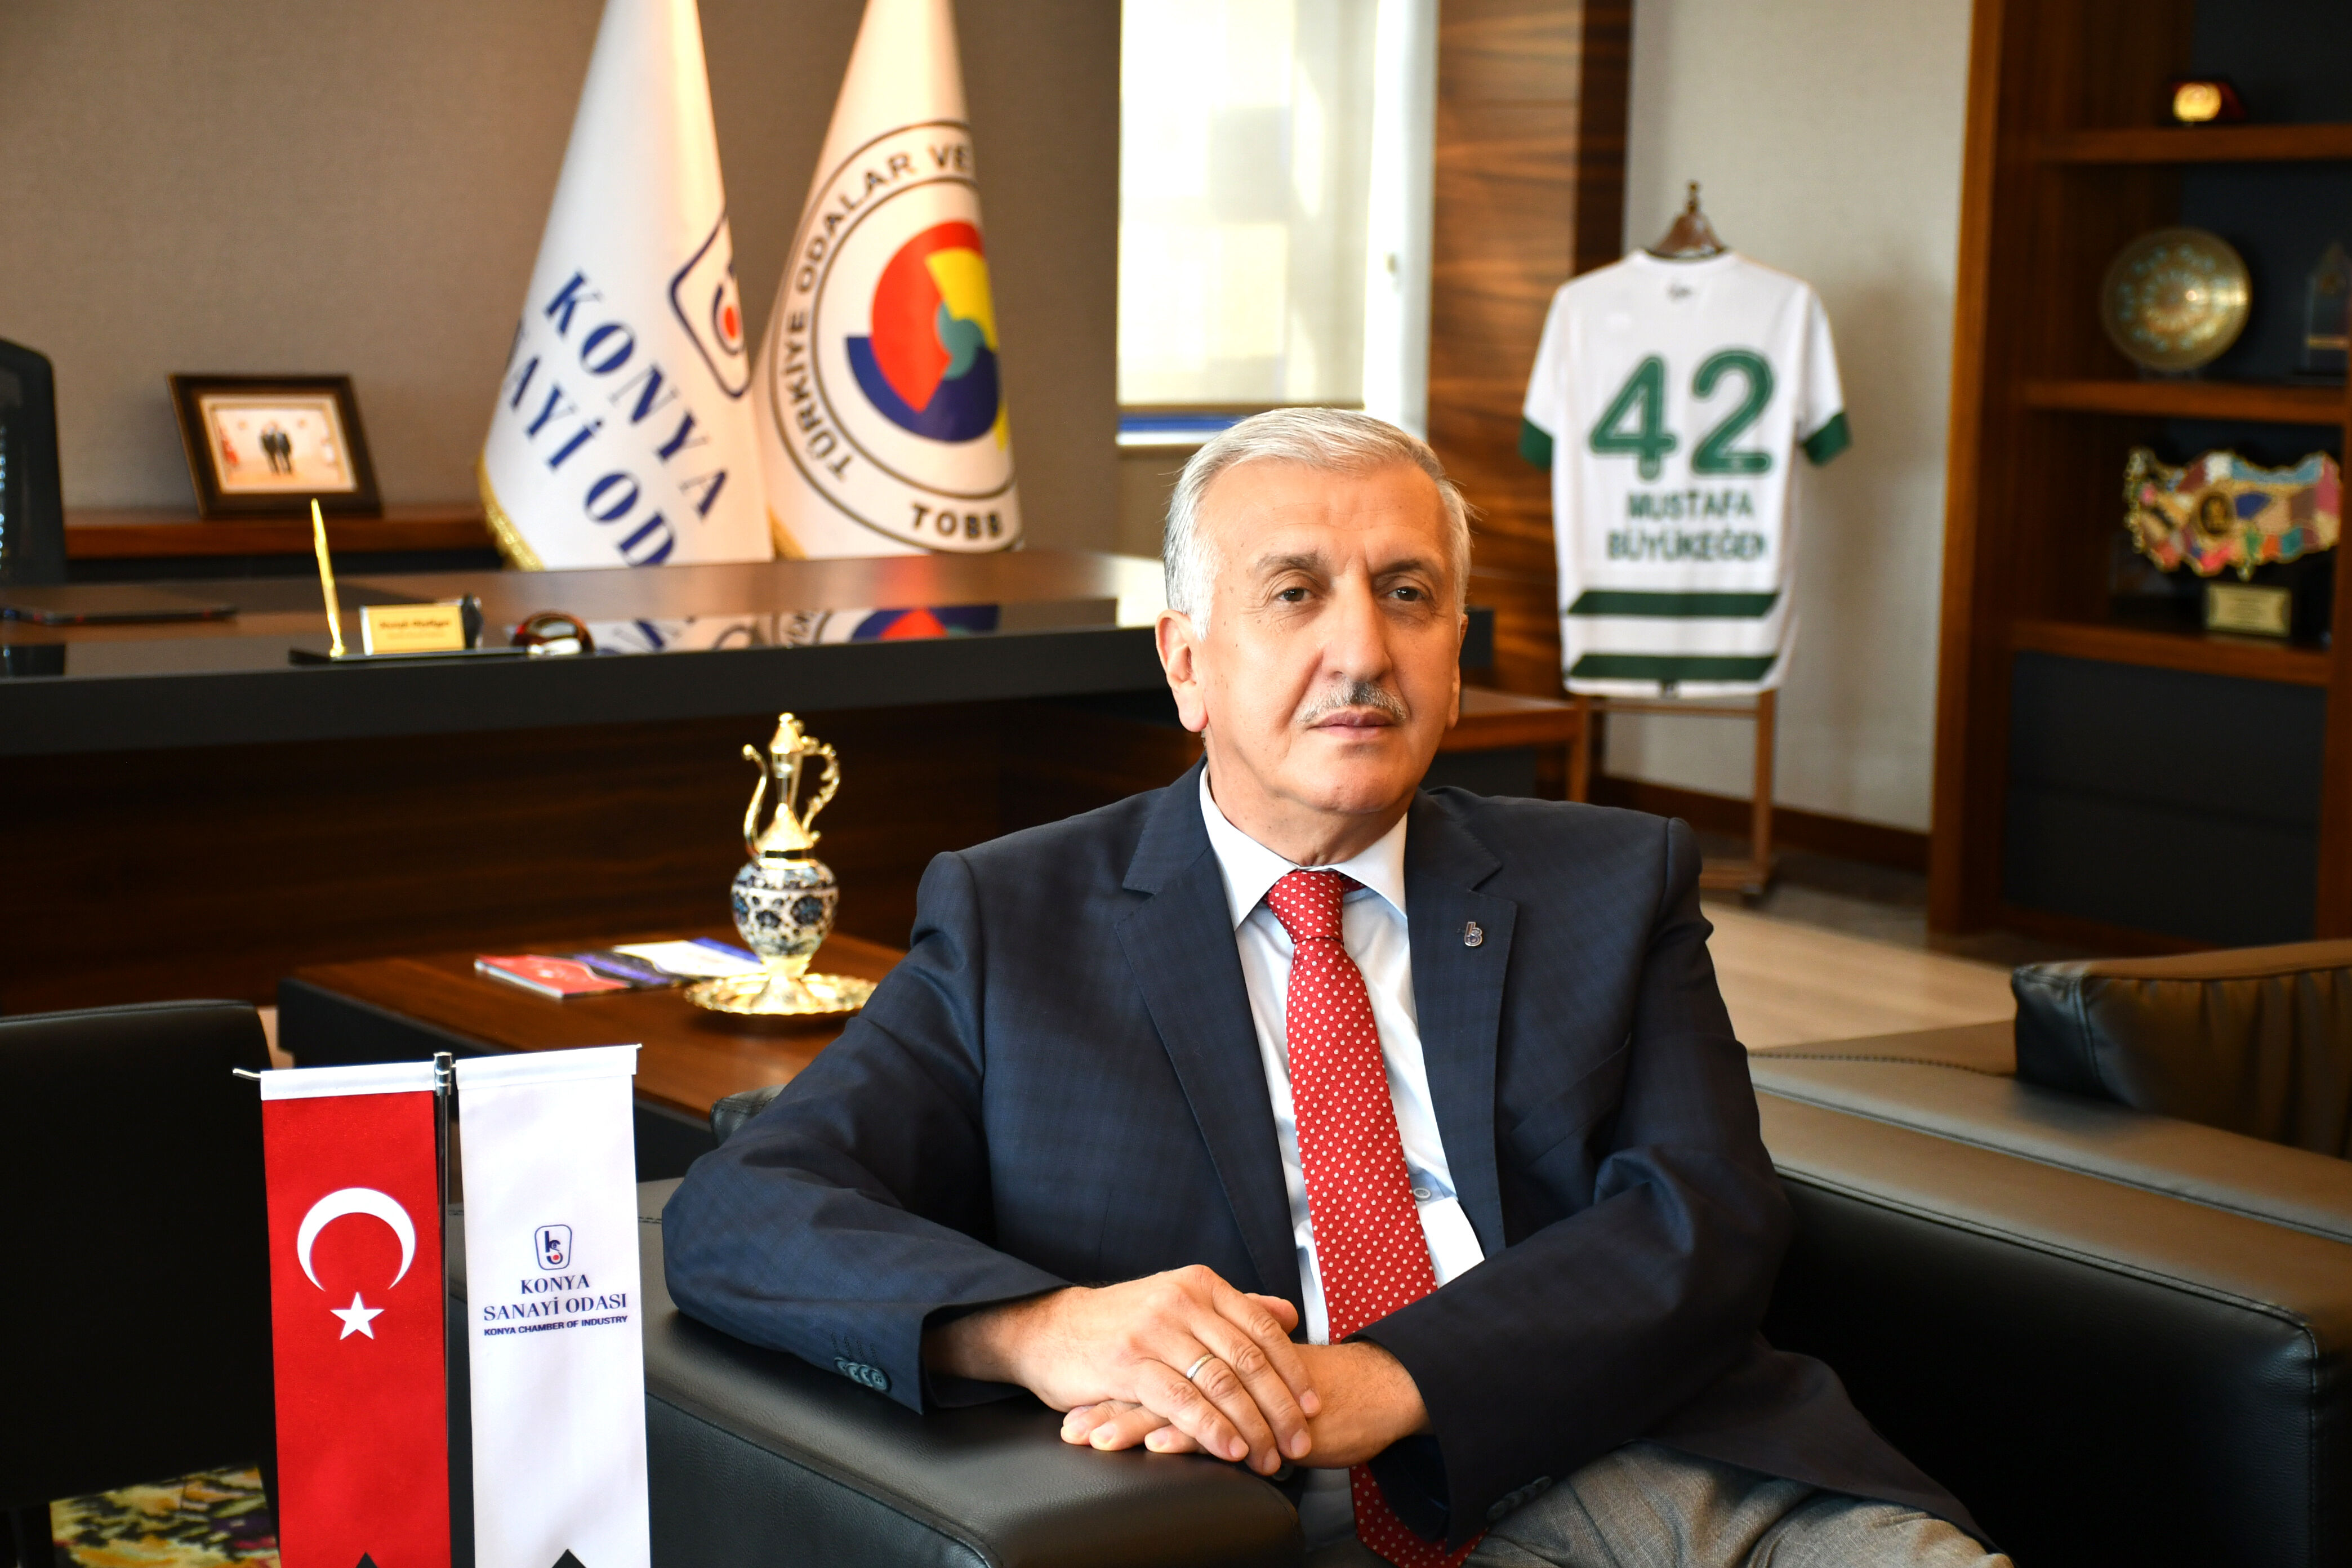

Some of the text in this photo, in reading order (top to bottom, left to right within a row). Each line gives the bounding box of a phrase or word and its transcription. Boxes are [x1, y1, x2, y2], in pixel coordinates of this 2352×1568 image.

[795, 151, 916, 293] ODALAR
[928, 144, 970, 171] VE
[503, 318, 604, 472] AYİ
[544, 268, 728, 520] KONYA
[1588, 350, 1774, 481] 42
[1627, 489, 1754, 519] MUSTAFA
[483, 1293, 626, 1321] SANAYİ ODASI
[521, 1274, 590, 1294] KONYA
[484, 1315, 628, 1336] KONYA CHAMBER OF INDUSTRY
